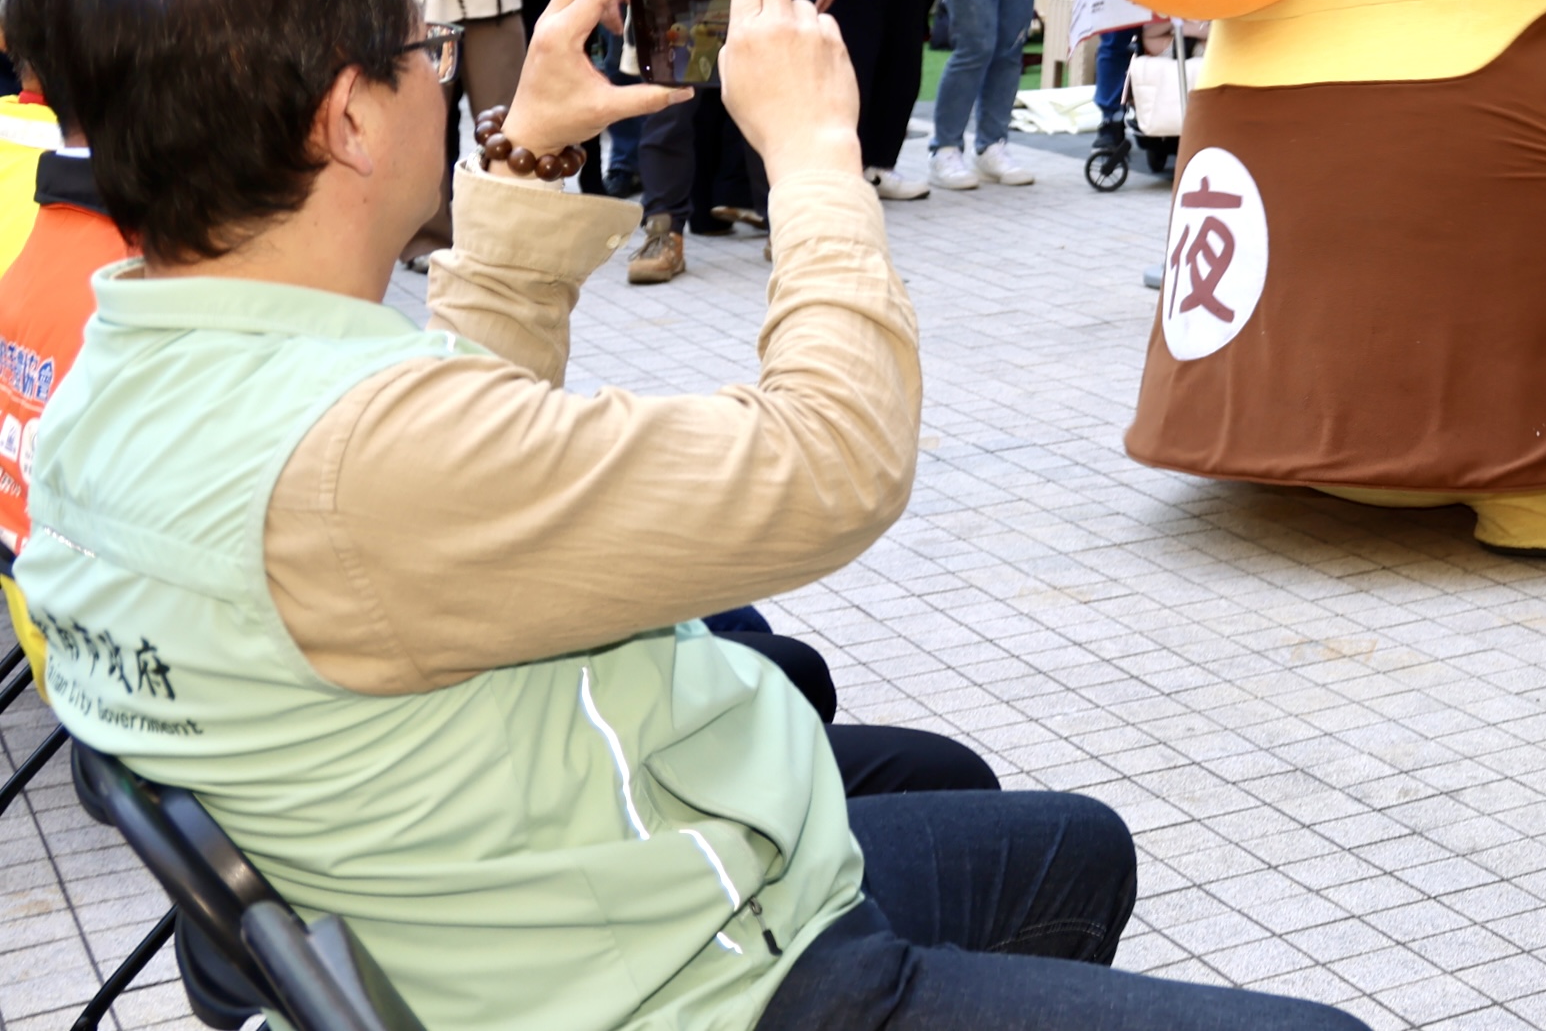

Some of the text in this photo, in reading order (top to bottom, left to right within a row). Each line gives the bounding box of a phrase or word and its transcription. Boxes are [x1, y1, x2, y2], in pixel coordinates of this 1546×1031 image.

[1168, 174, 1244, 325] 夜
[69, 678, 92, 717] City
[97, 696, 204, 737] Government
